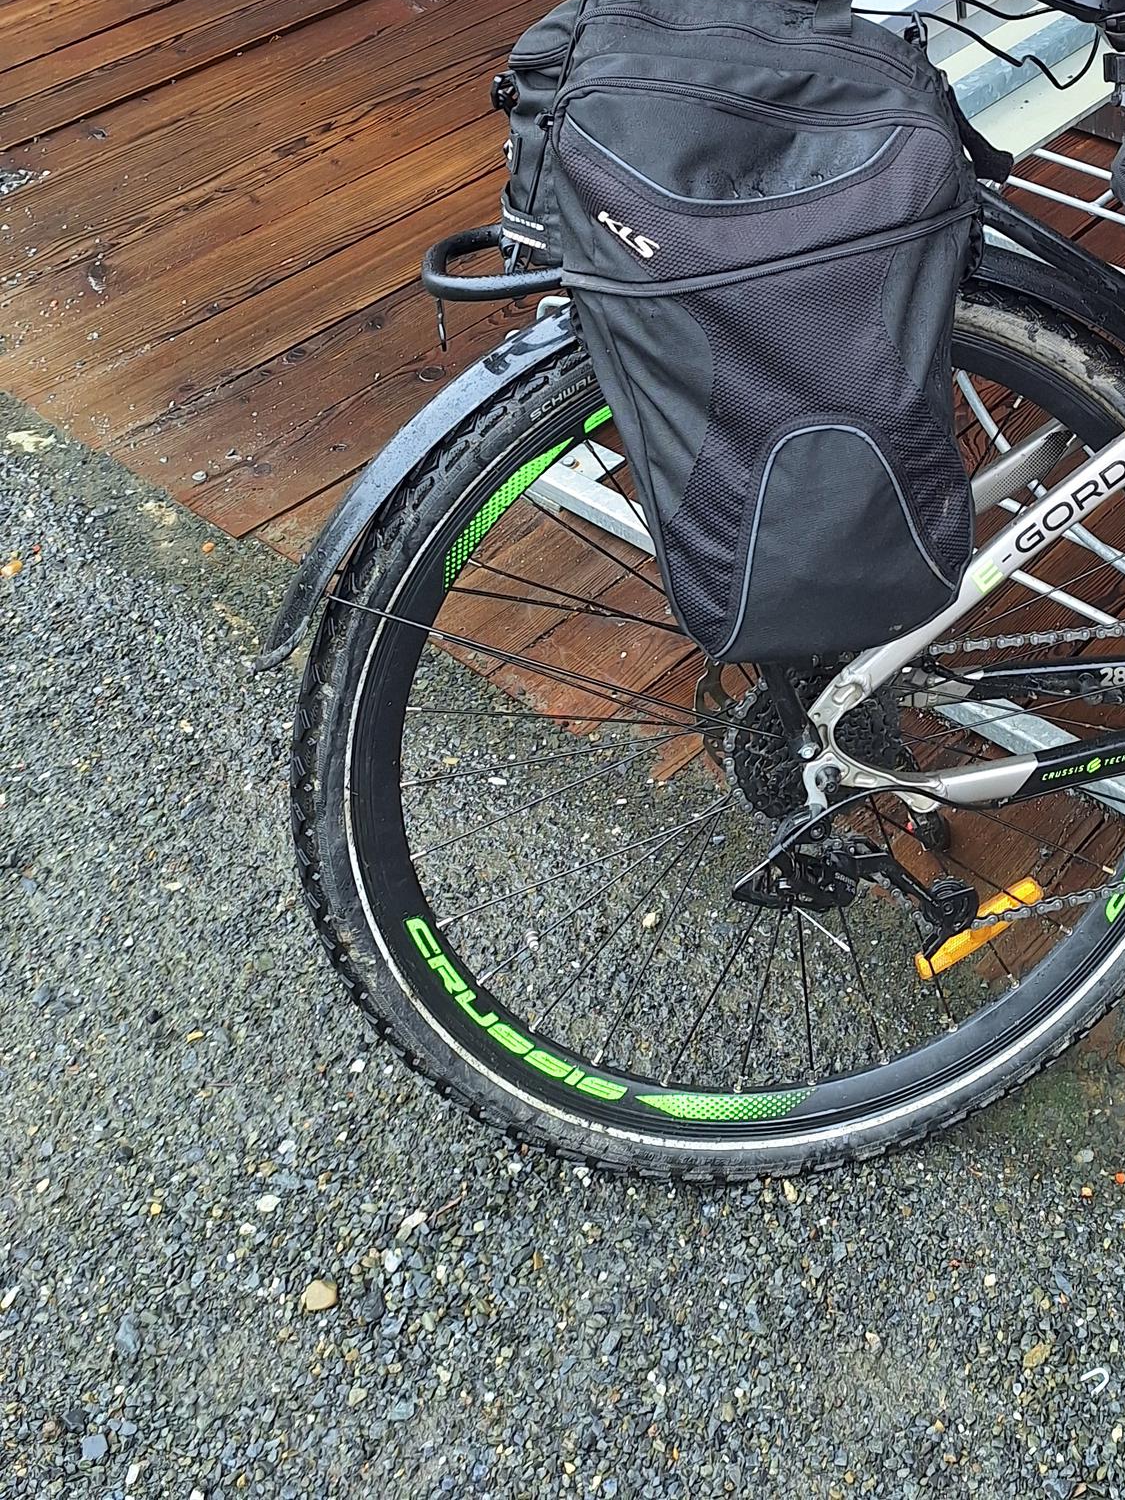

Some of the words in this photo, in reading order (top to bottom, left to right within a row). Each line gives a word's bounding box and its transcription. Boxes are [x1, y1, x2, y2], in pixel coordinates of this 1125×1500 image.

[597, 210, 660, 258] KLS
[1041, 764, 1085, 781] CRUSSIS
[405, 916, 629, 1101] CRUSSIS
